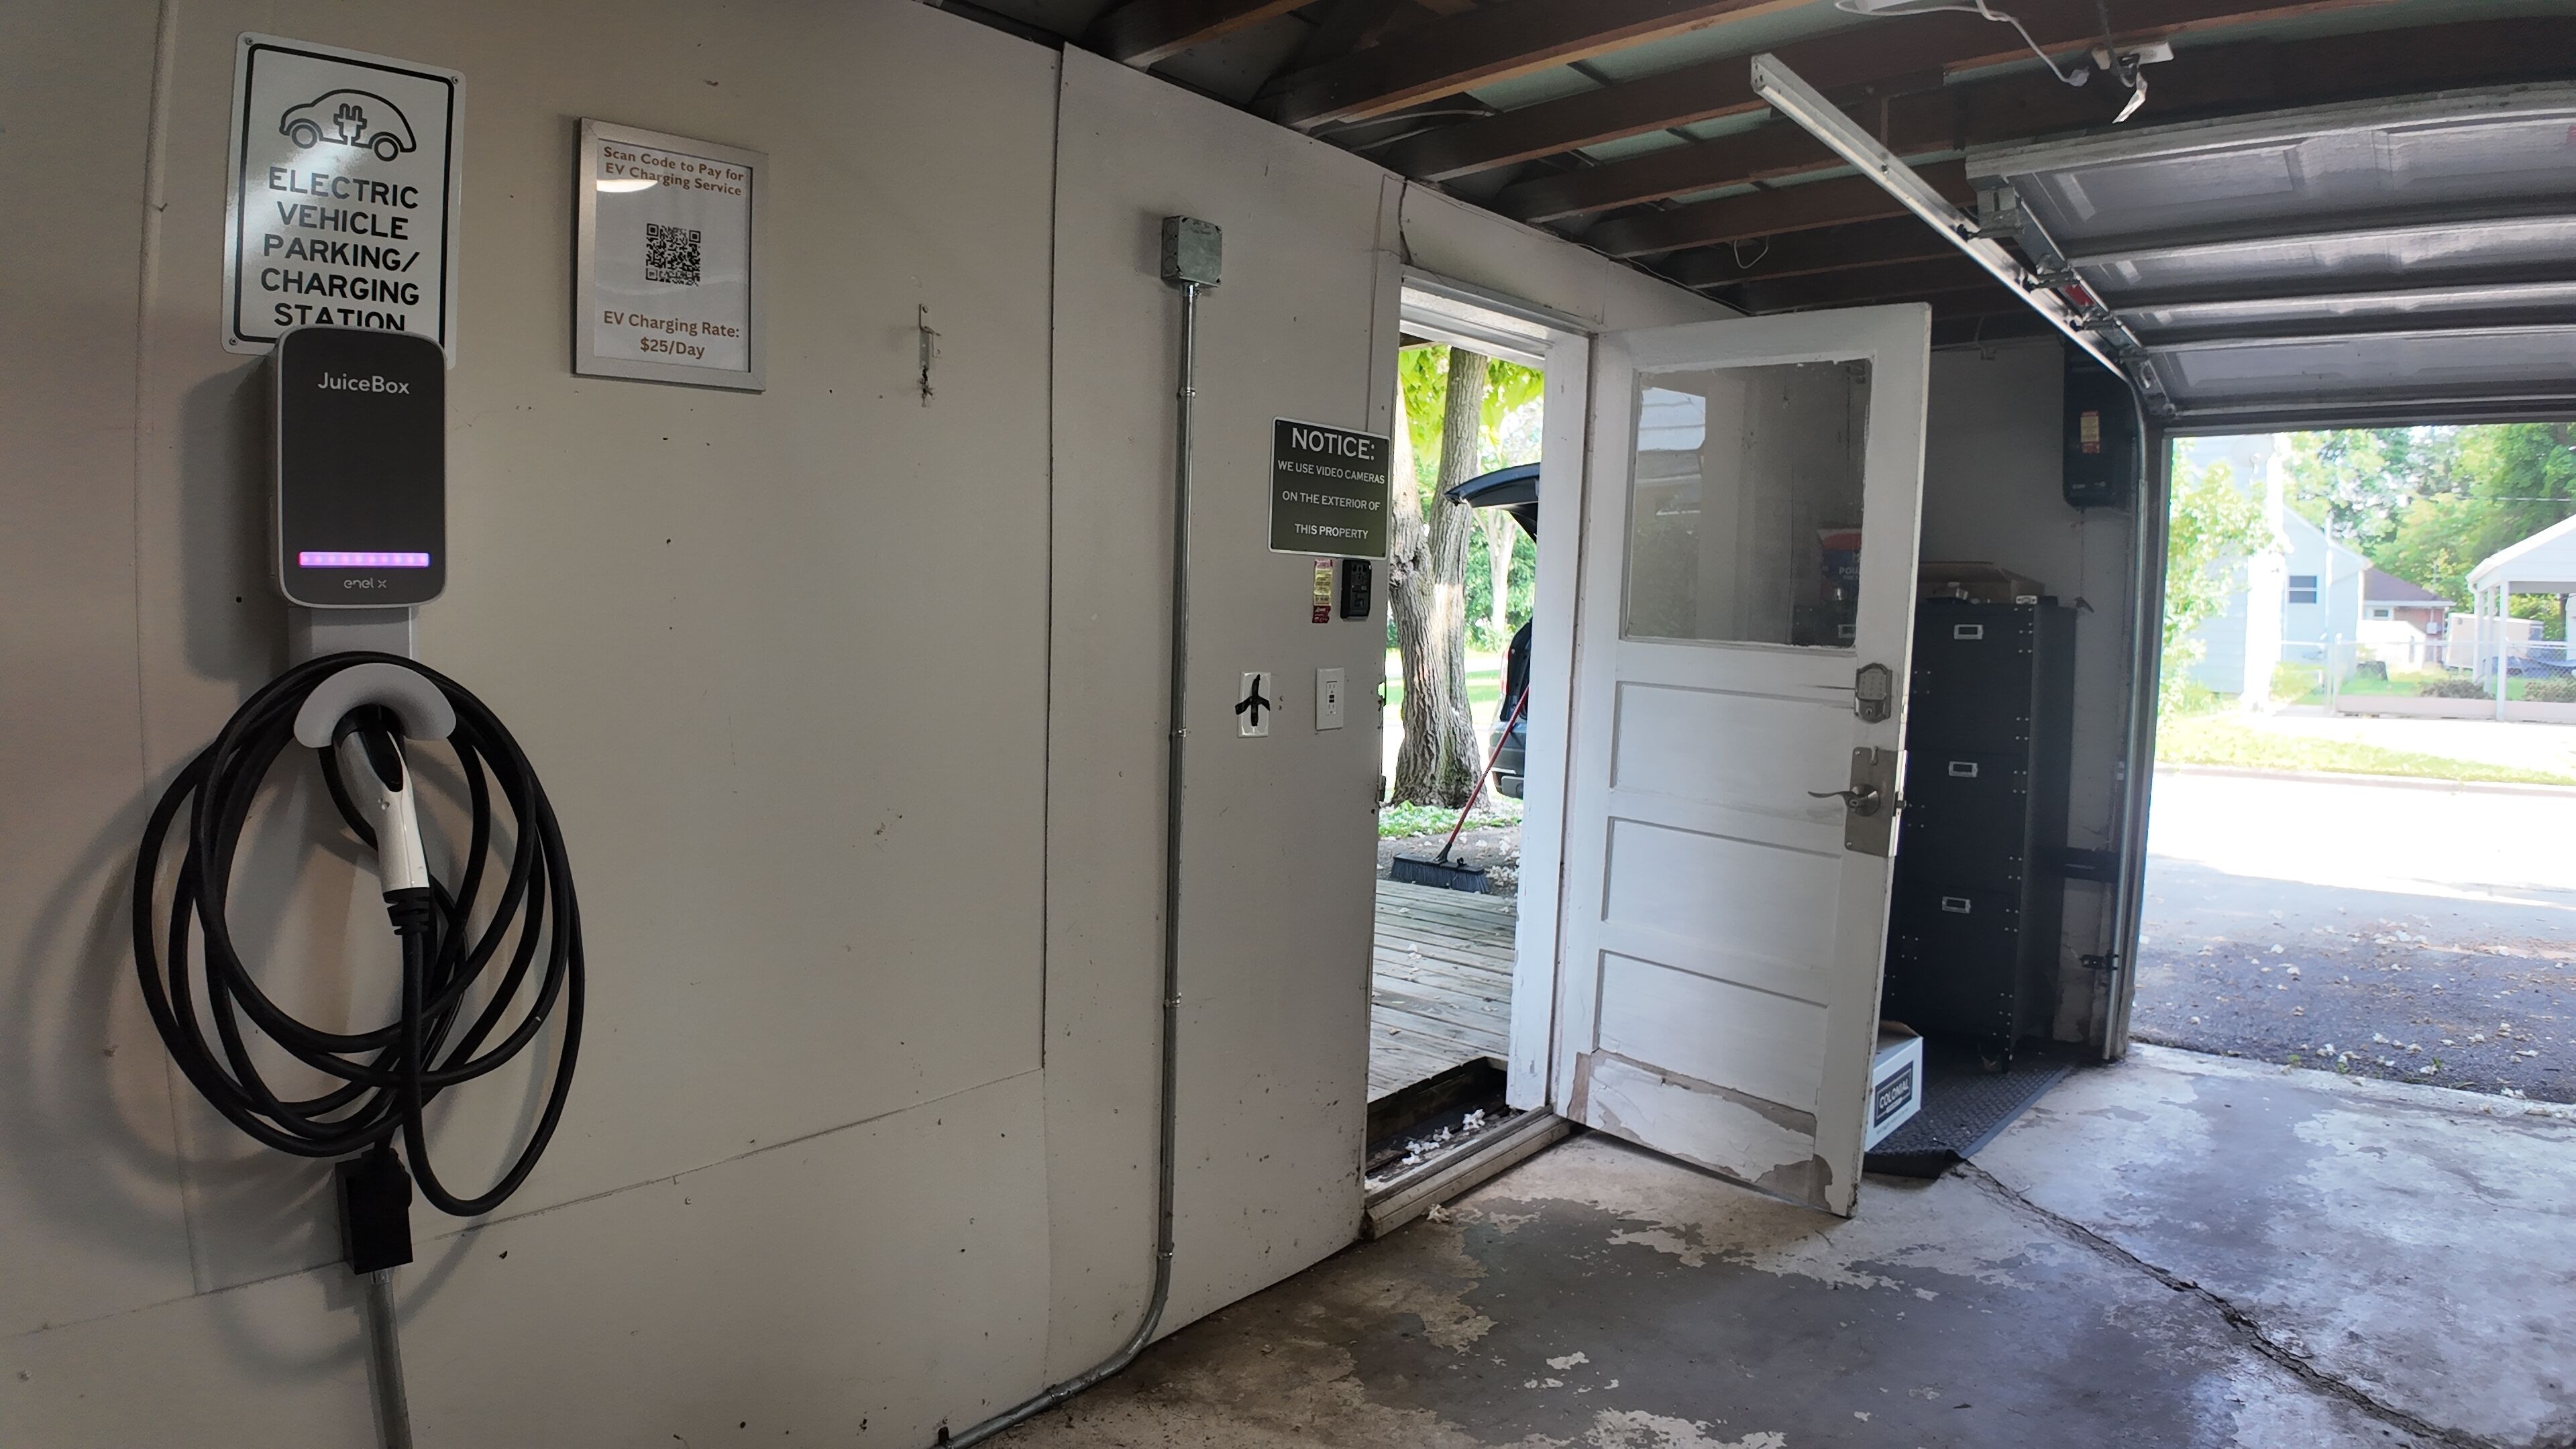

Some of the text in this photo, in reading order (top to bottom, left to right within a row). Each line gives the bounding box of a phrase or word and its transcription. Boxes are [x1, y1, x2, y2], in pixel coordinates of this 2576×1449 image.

[604, 146, 744, 181] Scan Code to Pay for
[268, 166, 419, 209] ELECTRIC
[606, 162, 741, 196] EV Charging Service
[277, 201, 409, 240] VEHICLE
[264, 234, 420, 272] PARKING/
[261, 268, 419, 305] CHARGING
[274, 303, 405, 331] STATION
[604, 311, 739, 338] EV Charging Rate:
[640, 337, 705, 360] $25/Day
[317, 372, 410, 394] JuiceBox
[1291, 427, 1375, 461] NOTICE:
[1278, 460, 1385, 484] WE USE VIDEO CAMERAS
[1282, 490, 1381, 511] ON THE EXTERIOR OF
[1295, 523, 1368, 539] THIS PROPERTY
[343, 578, 374, 589] enel
[1879, 1077, 1909, 1109] COLONIAL
